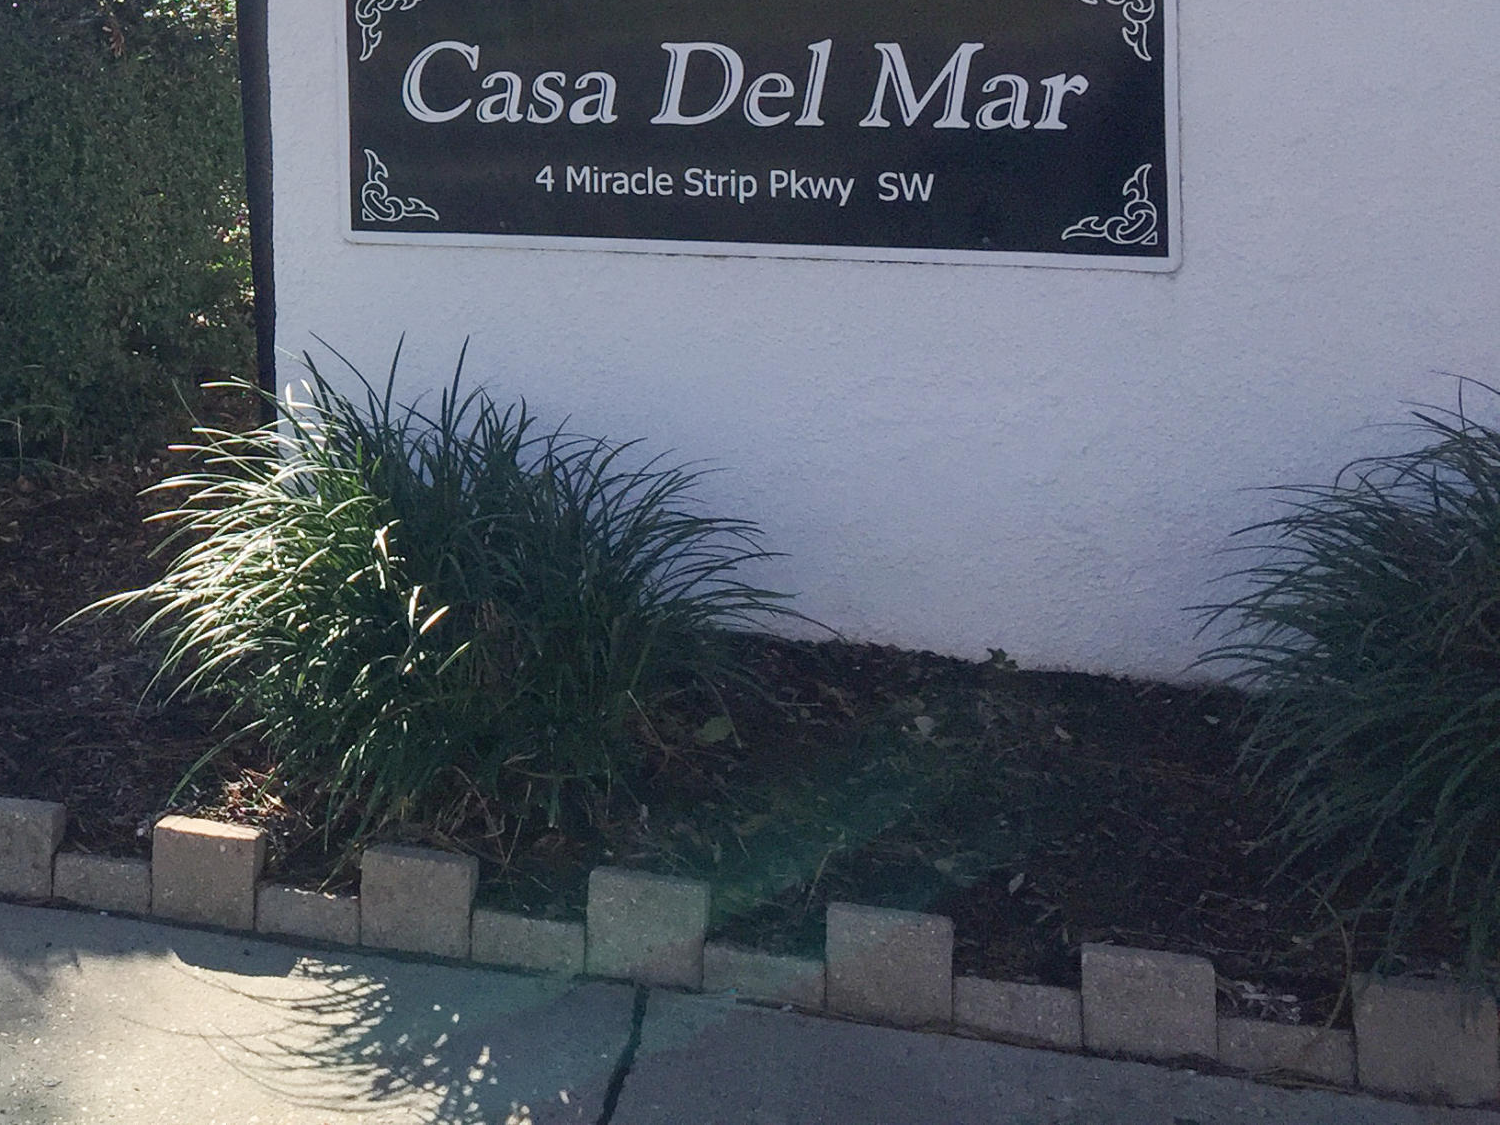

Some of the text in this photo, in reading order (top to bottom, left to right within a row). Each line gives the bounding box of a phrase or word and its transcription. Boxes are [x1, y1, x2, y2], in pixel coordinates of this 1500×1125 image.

[402, 38, 1090, 131] Casa Del Mar
[535, 165, 935, 207] 4 Miracle Strip Pkwy SW
